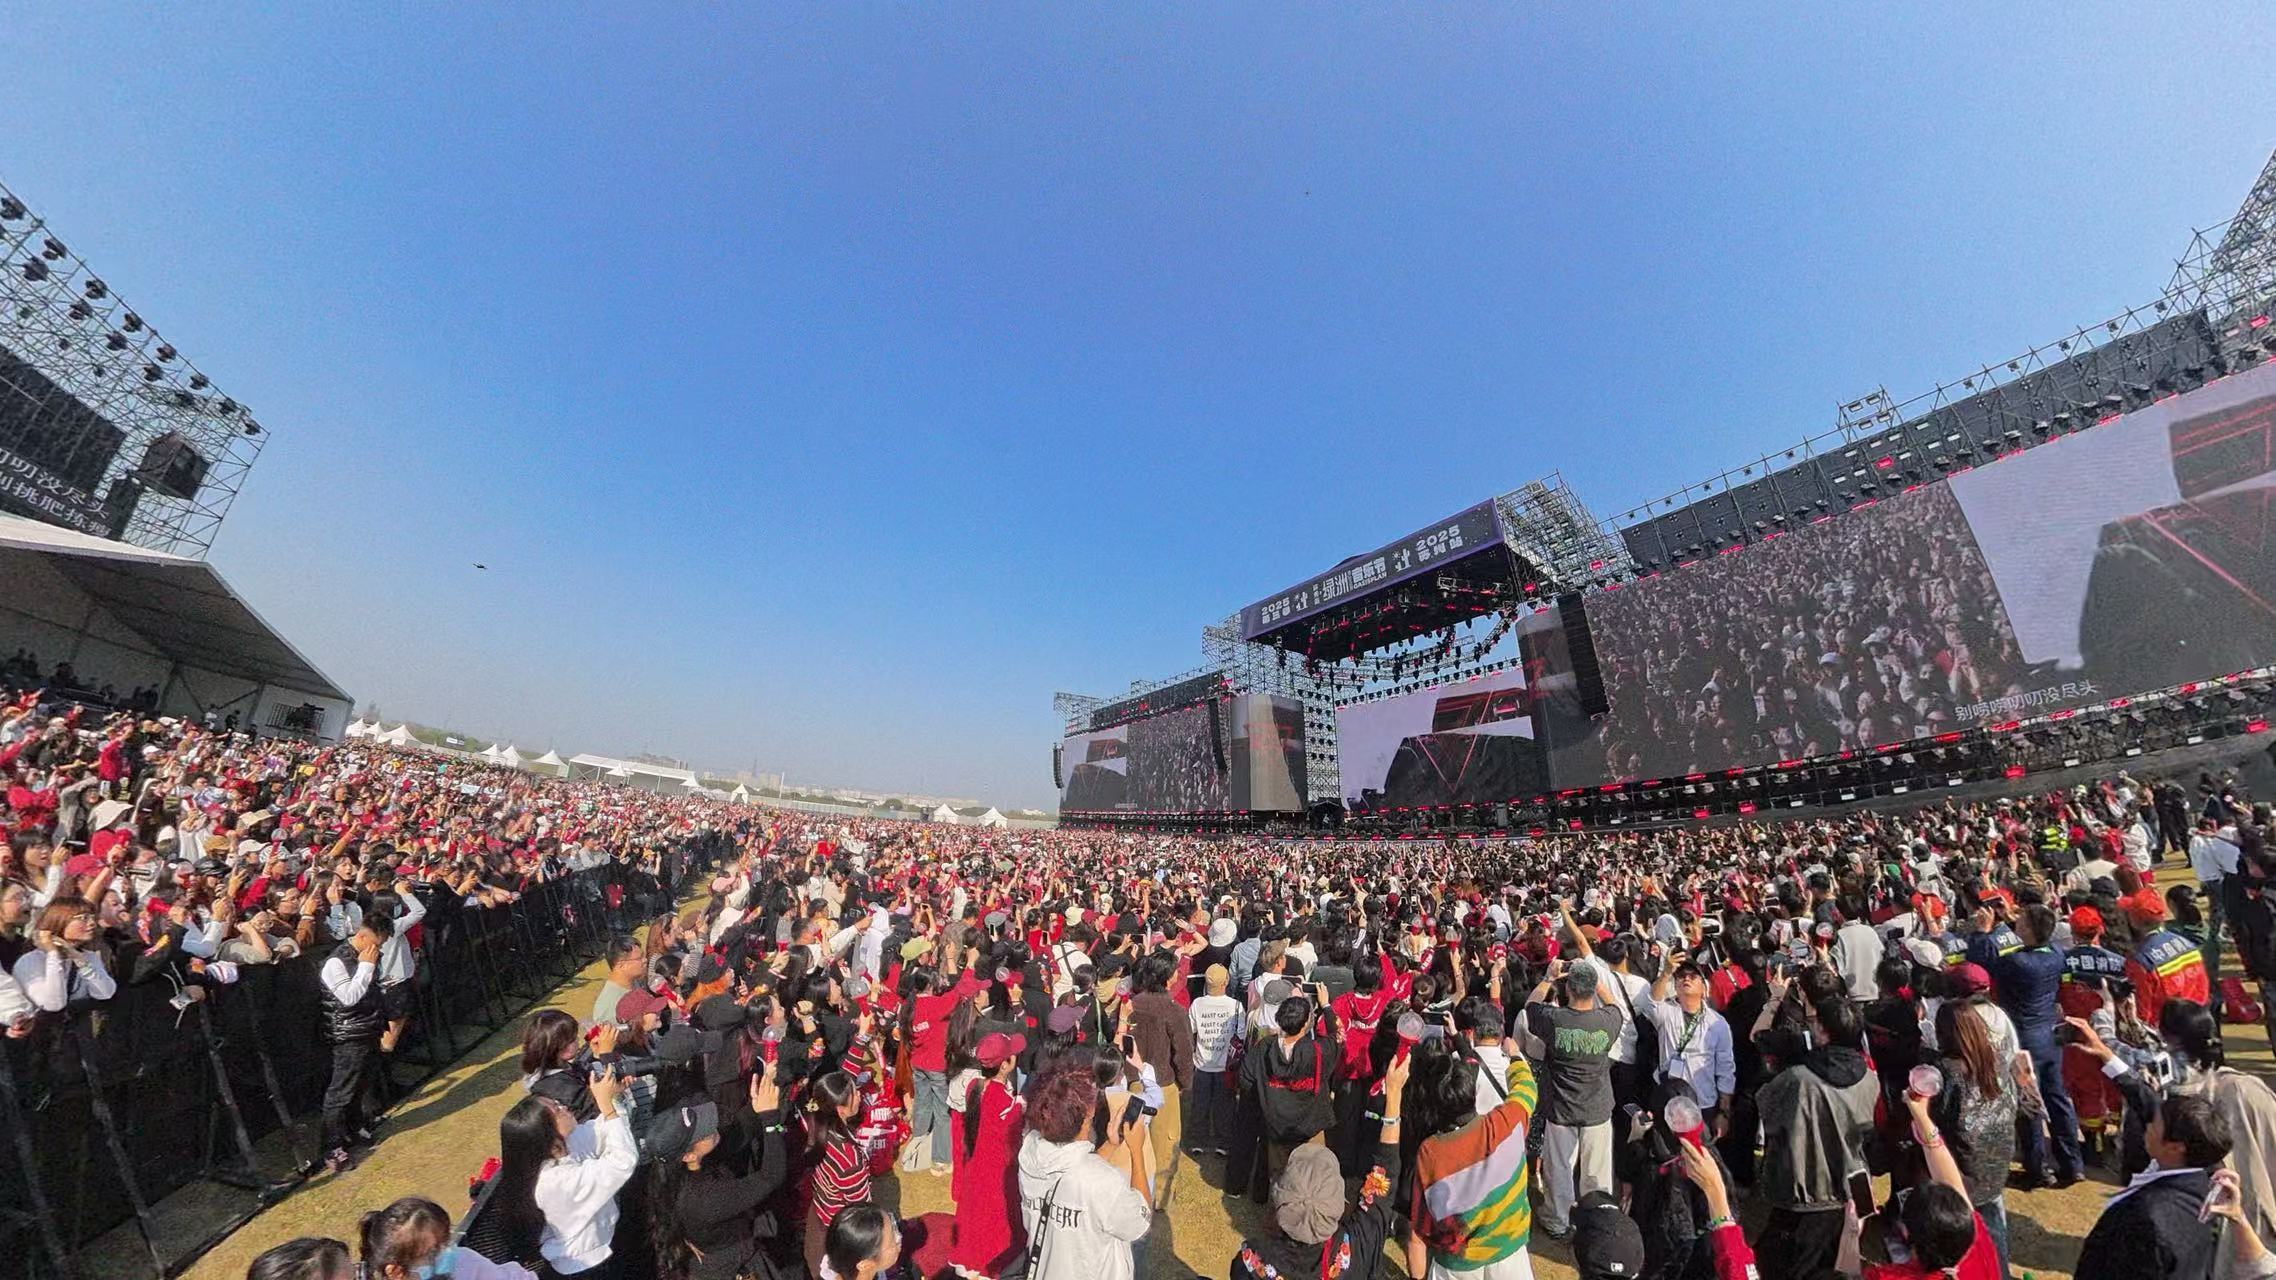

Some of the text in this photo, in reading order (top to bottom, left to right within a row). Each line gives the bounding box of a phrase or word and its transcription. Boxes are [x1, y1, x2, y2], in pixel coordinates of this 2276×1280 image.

[1416, 524, 1460, 551] 2025
[1261, 597, 1290, 616] 2025
[1954, 679, 2098, 722] 别唠唠叨叨没尽头
